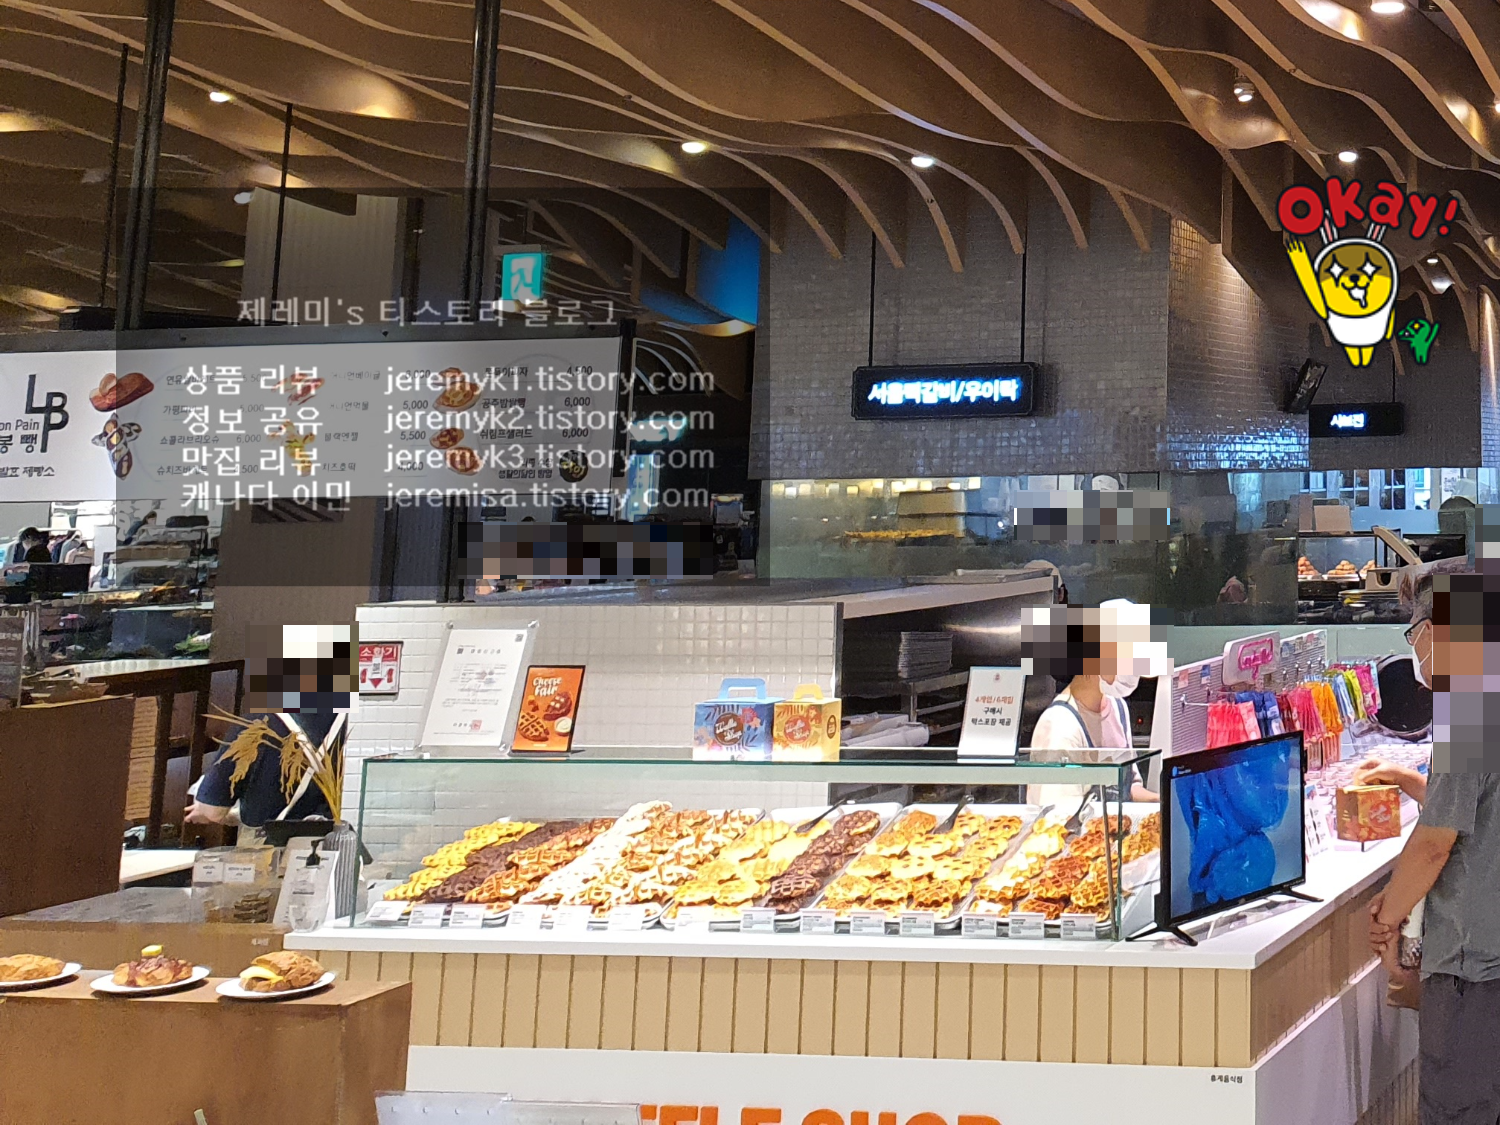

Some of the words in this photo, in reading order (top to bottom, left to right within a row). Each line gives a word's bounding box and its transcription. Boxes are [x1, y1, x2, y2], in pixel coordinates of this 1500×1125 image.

[402, 400, 429, 410] 5,000
[564, 396, 591, 407] 6,000
[15, 419, 39, 431] Pain
[400, 431, 426, 441] 5,500
[562, 428, 588, 438] 6,000
[236, 434, 262, 444] 6,000
[983, 707, 1003, 715] 구매시
